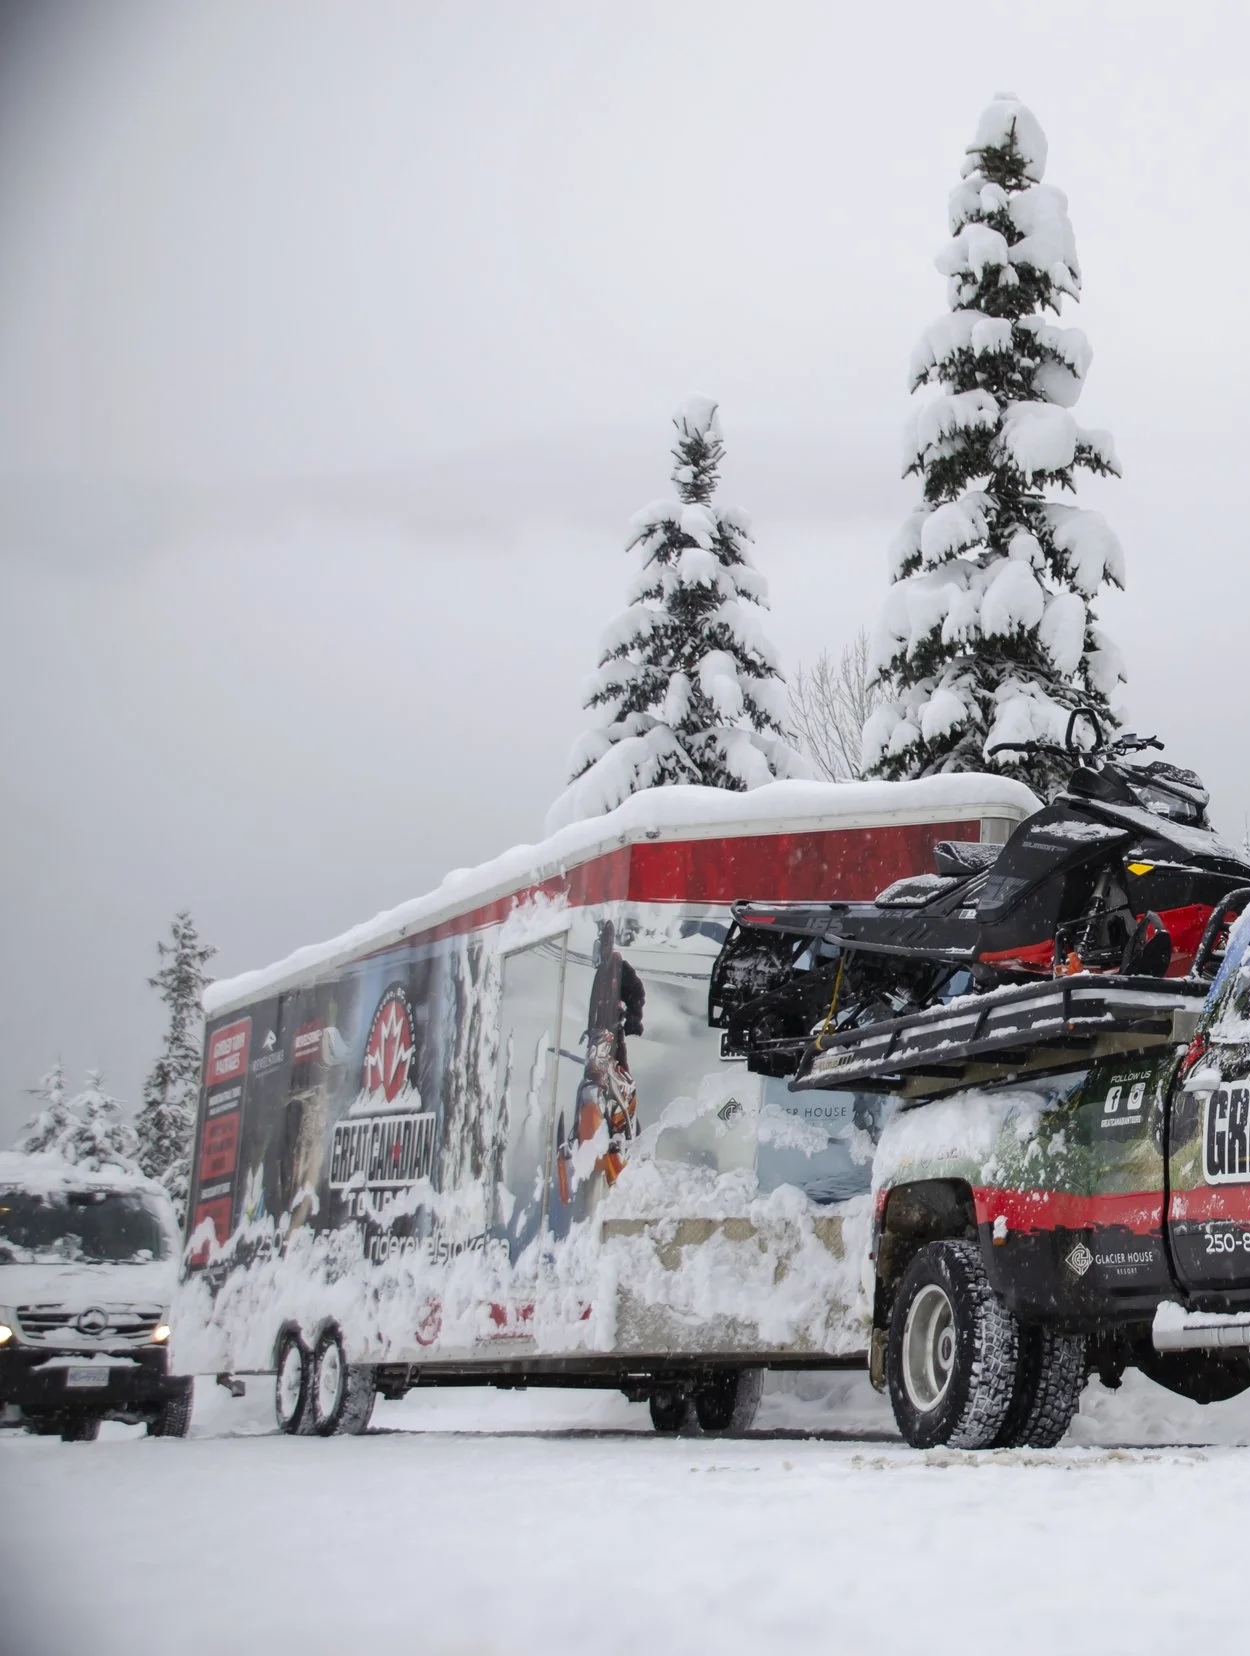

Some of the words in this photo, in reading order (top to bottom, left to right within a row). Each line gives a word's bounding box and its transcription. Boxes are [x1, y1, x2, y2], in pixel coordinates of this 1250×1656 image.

[1110, 1071, 1141, 1083] FOLLOW
[1140, 1069, 1152, 1078] US
[804, 1106, 847, 1118] HOUSE
[1095, 1252, 1126, 1265] GLACIER
[1127, 1251, 1154, 1263] HOUSE
[1116, 1267, 1138, 1275] RESORT
